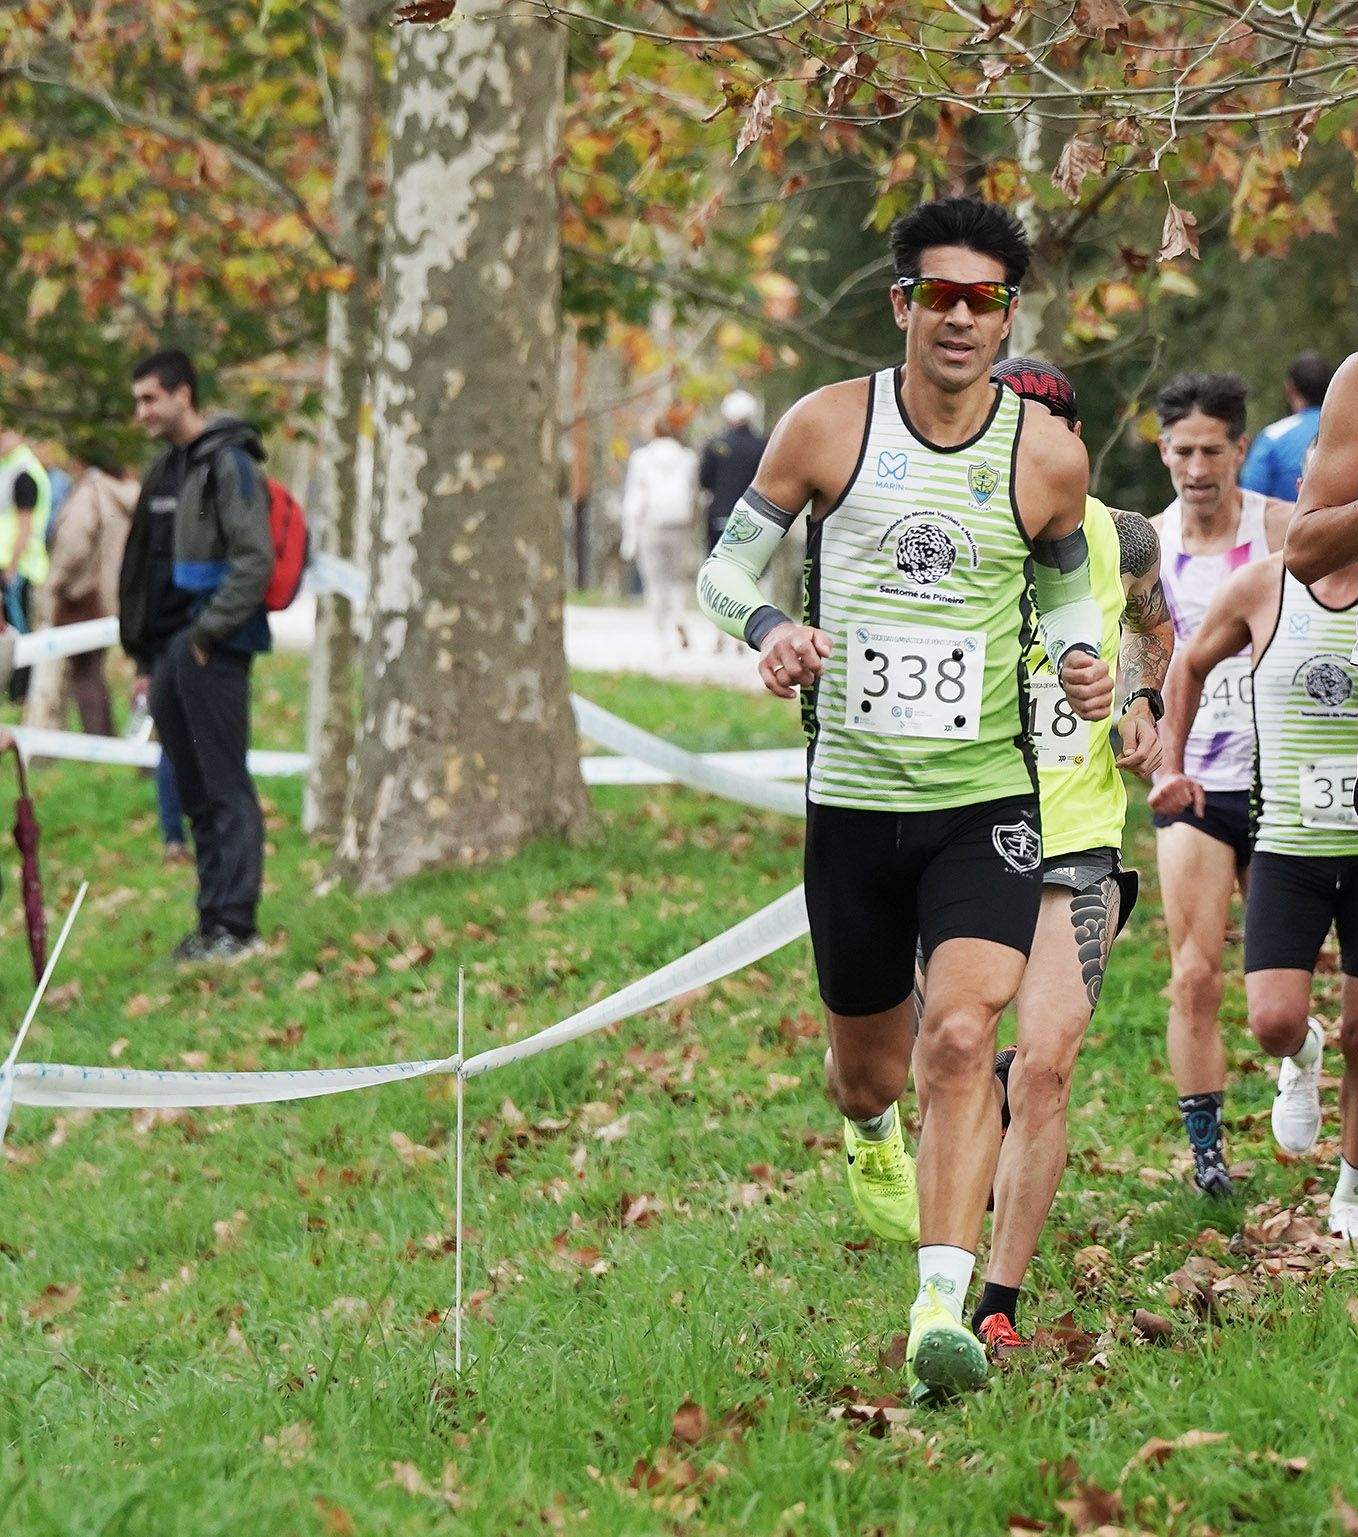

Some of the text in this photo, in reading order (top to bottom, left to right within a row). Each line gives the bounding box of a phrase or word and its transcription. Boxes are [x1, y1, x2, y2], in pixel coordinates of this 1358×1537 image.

[700, 573, 752, 621] PINARIUM
[879, 585, 919, 598] Santomé
[920, 592, 931, 600] de
[863, 649, 966, 704] 338
